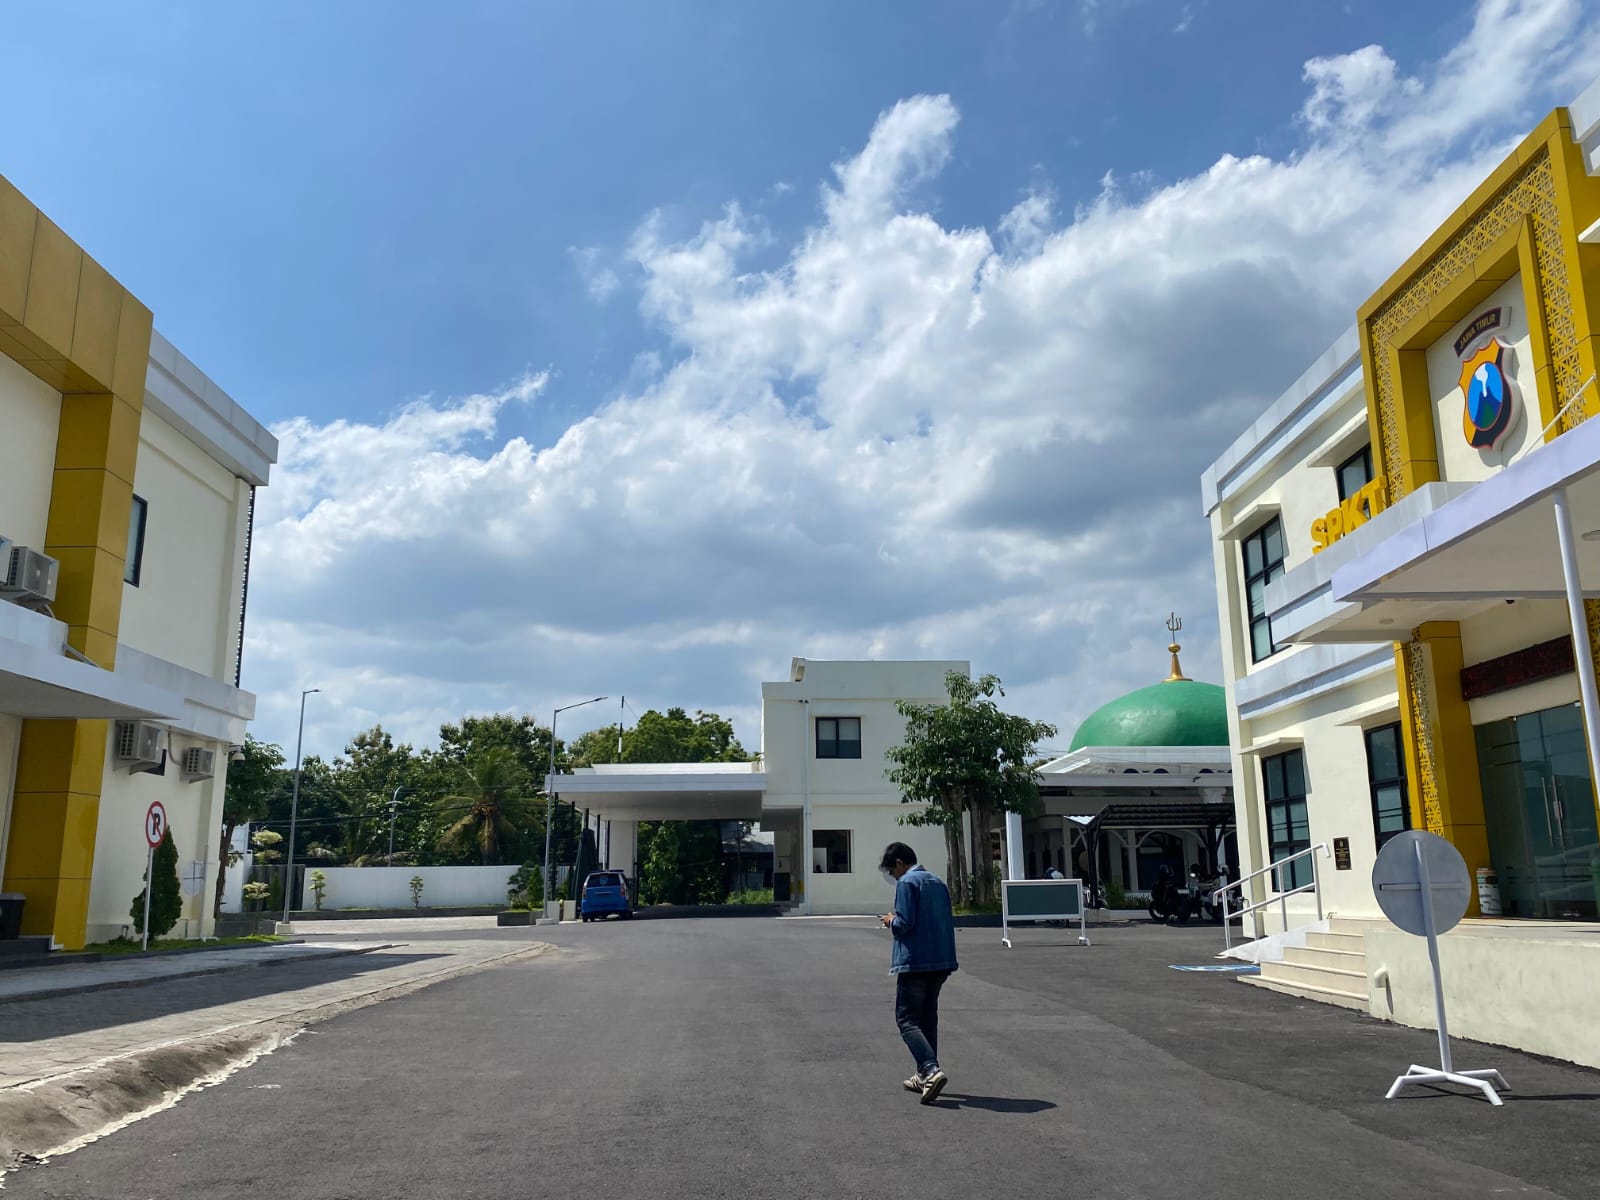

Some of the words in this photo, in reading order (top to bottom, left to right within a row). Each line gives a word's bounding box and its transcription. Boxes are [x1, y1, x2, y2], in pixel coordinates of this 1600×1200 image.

[1476, 313, 1496, 331] TIMUR
[1311, 476, 1387, 555] SPKT
[152, 813, 161, 835] P
